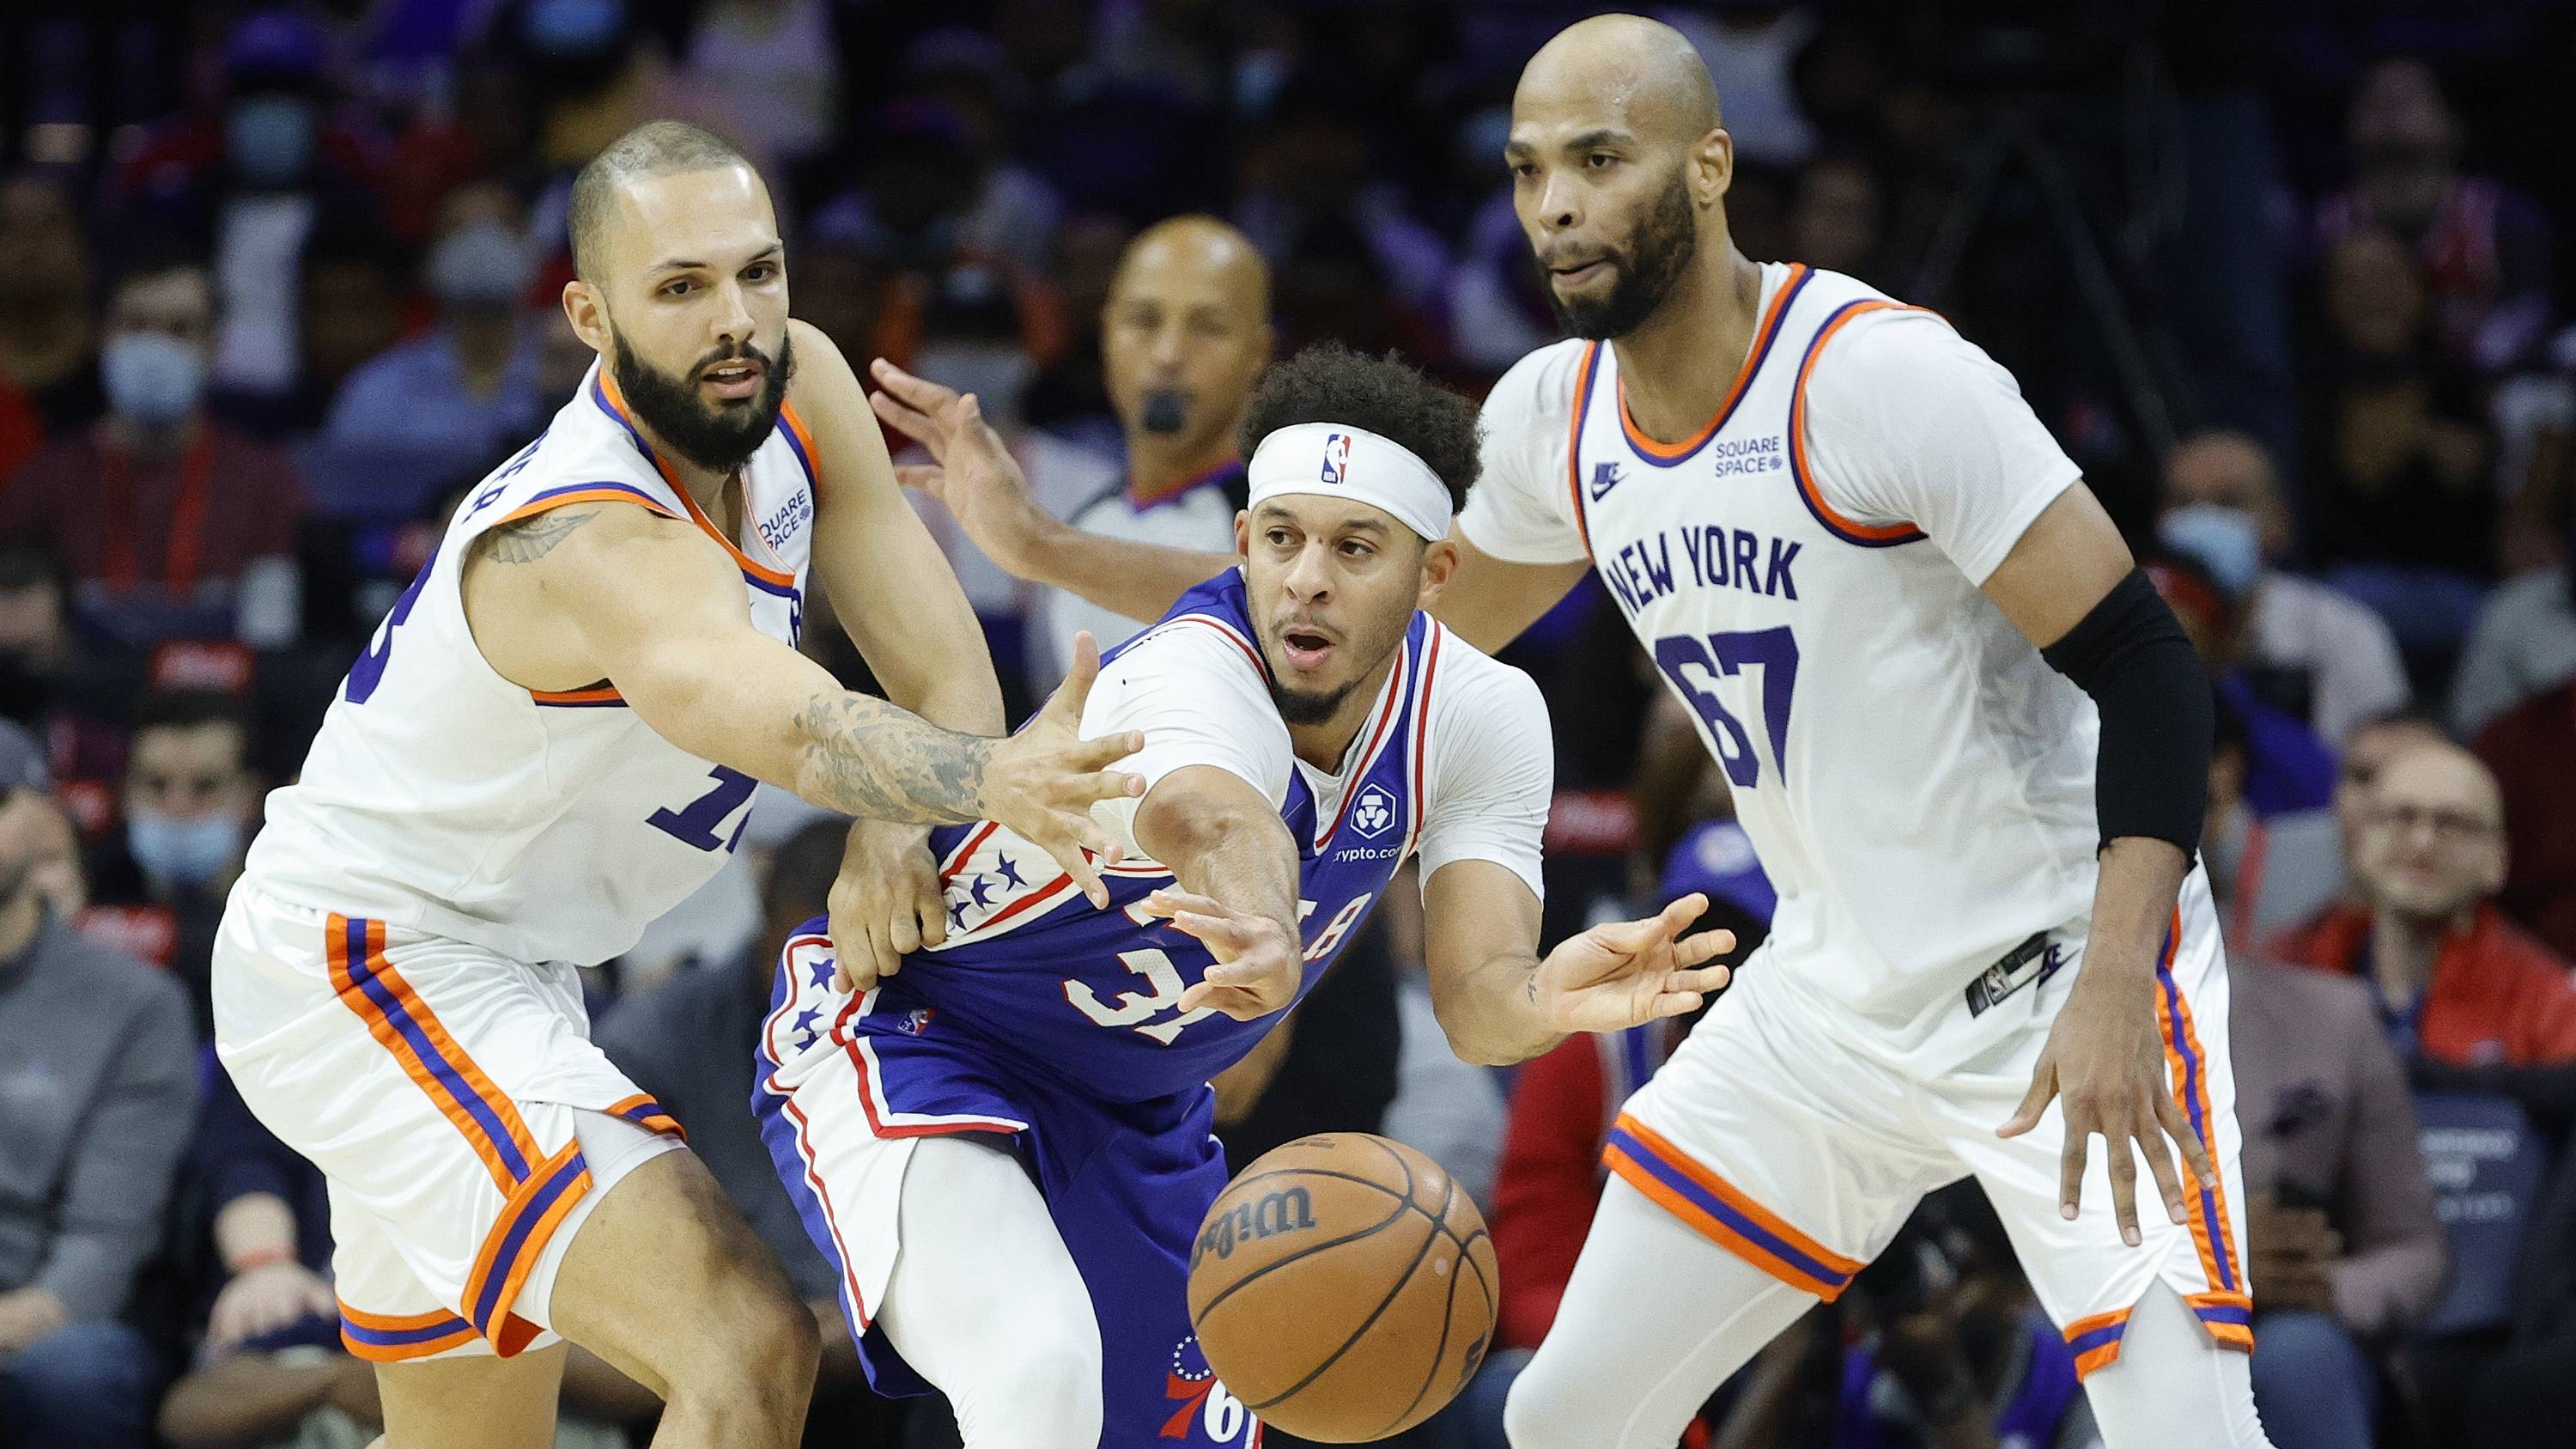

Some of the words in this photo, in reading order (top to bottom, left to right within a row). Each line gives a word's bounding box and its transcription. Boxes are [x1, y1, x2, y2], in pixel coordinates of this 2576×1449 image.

[1715, 456, 1765, 478] SPACE
[1716, 436, 1780, 459] SQUARE
[759, 489, 807, 540] QUARE
[1607, 531, 1675, 622] NEW
[1680, 524, 1803, 601] YORK
[1656, 624, 1800, 789] 67
[644, 764, 760, 855] 1
[1333, 844, 1402, 863] rypto.co
[1158, 1372, 1245, 1444] 76
